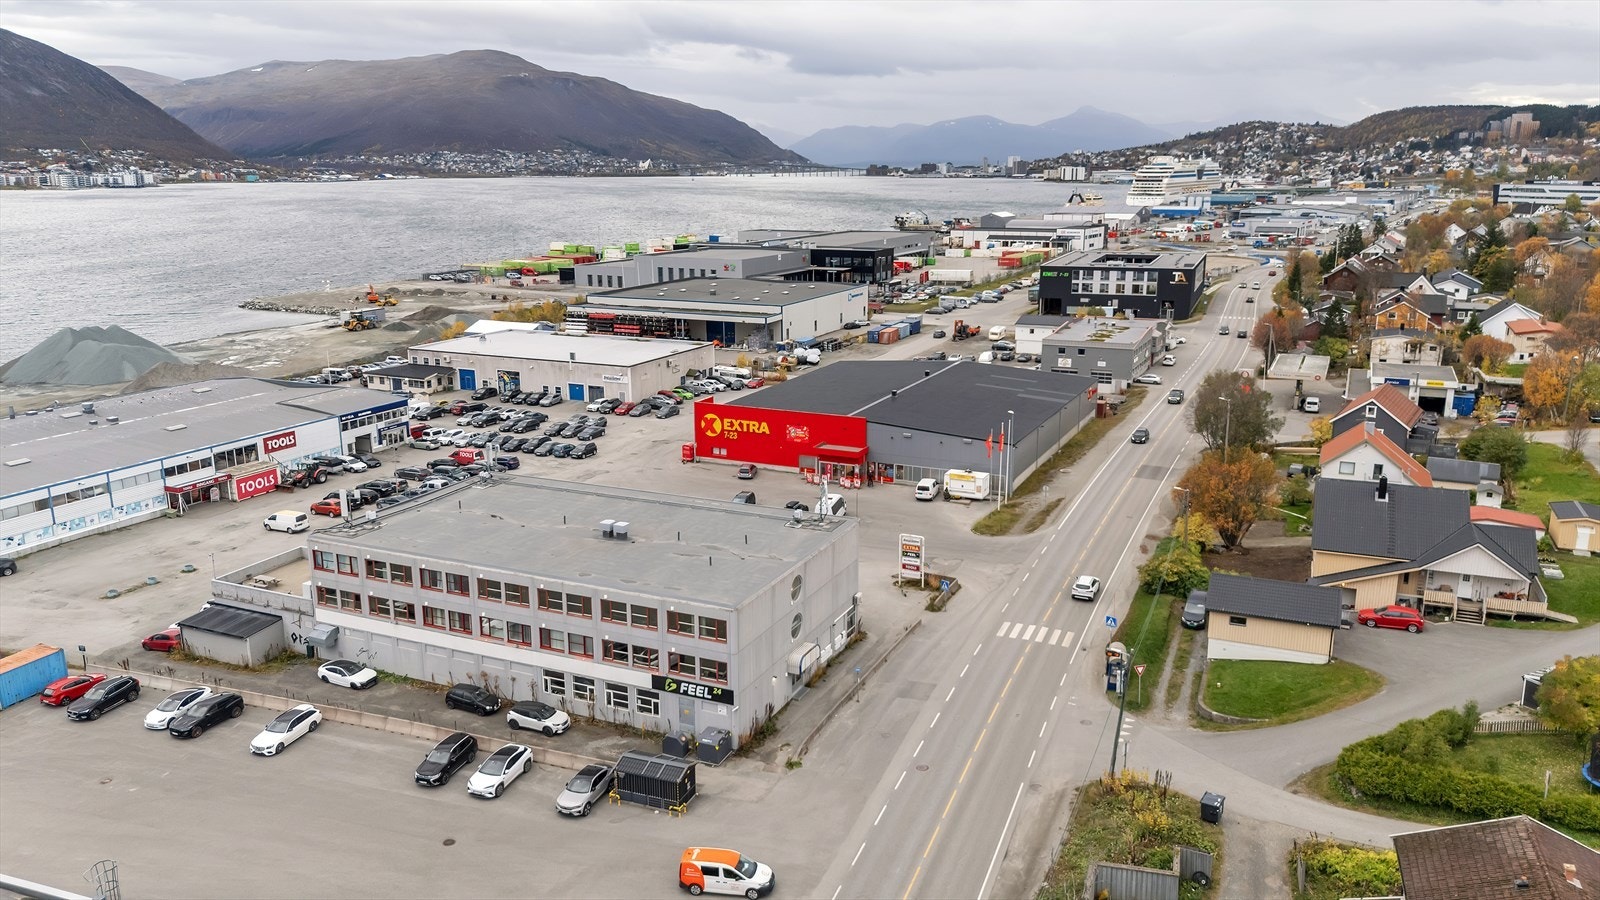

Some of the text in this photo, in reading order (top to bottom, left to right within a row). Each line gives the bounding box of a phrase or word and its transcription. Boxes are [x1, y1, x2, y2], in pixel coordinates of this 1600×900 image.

[723, 418, 770, 435] EXTRA
[266, 435, 295, 450] TOOLS
[724, 431, 738, 440] 7-23
[240, 474, 275, 494] TOOLS
[680, 682, 722, 699] FEEL 24
